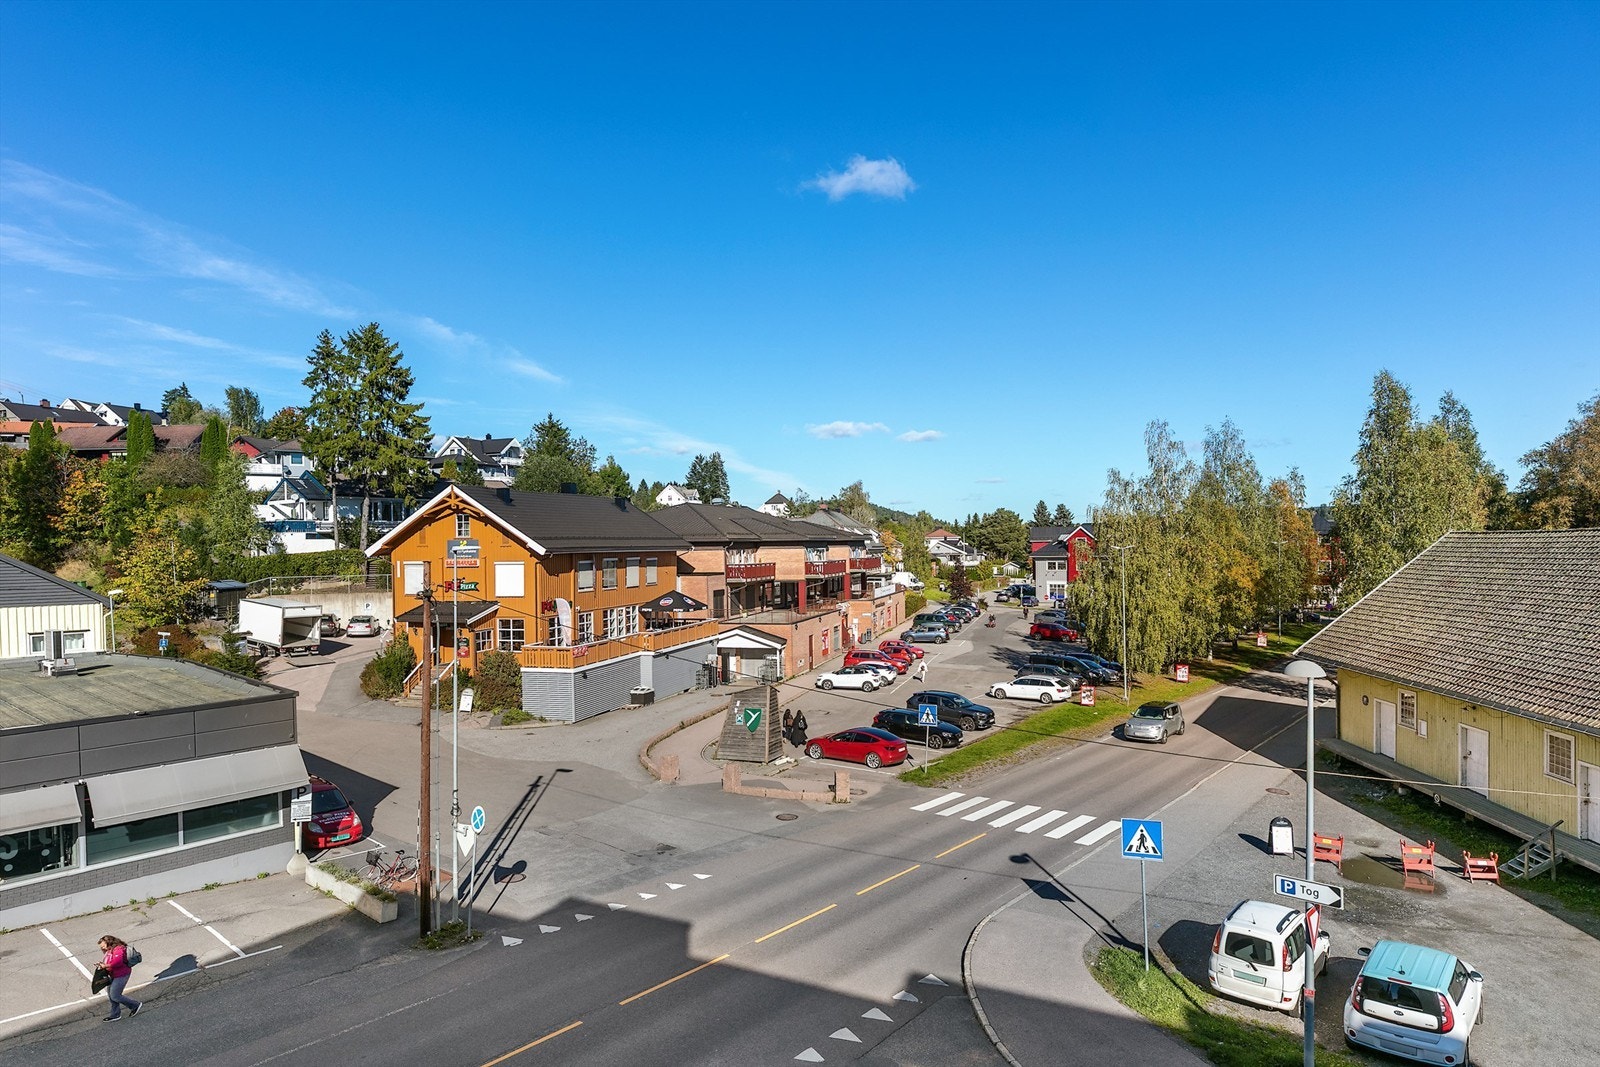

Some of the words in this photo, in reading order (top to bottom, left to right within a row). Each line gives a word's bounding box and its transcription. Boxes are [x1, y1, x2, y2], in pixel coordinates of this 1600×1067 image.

[297, 786, 307, 799] P
[1284, 881, 1293, 893] P
[1300, 885, 1319, 899] Tog
